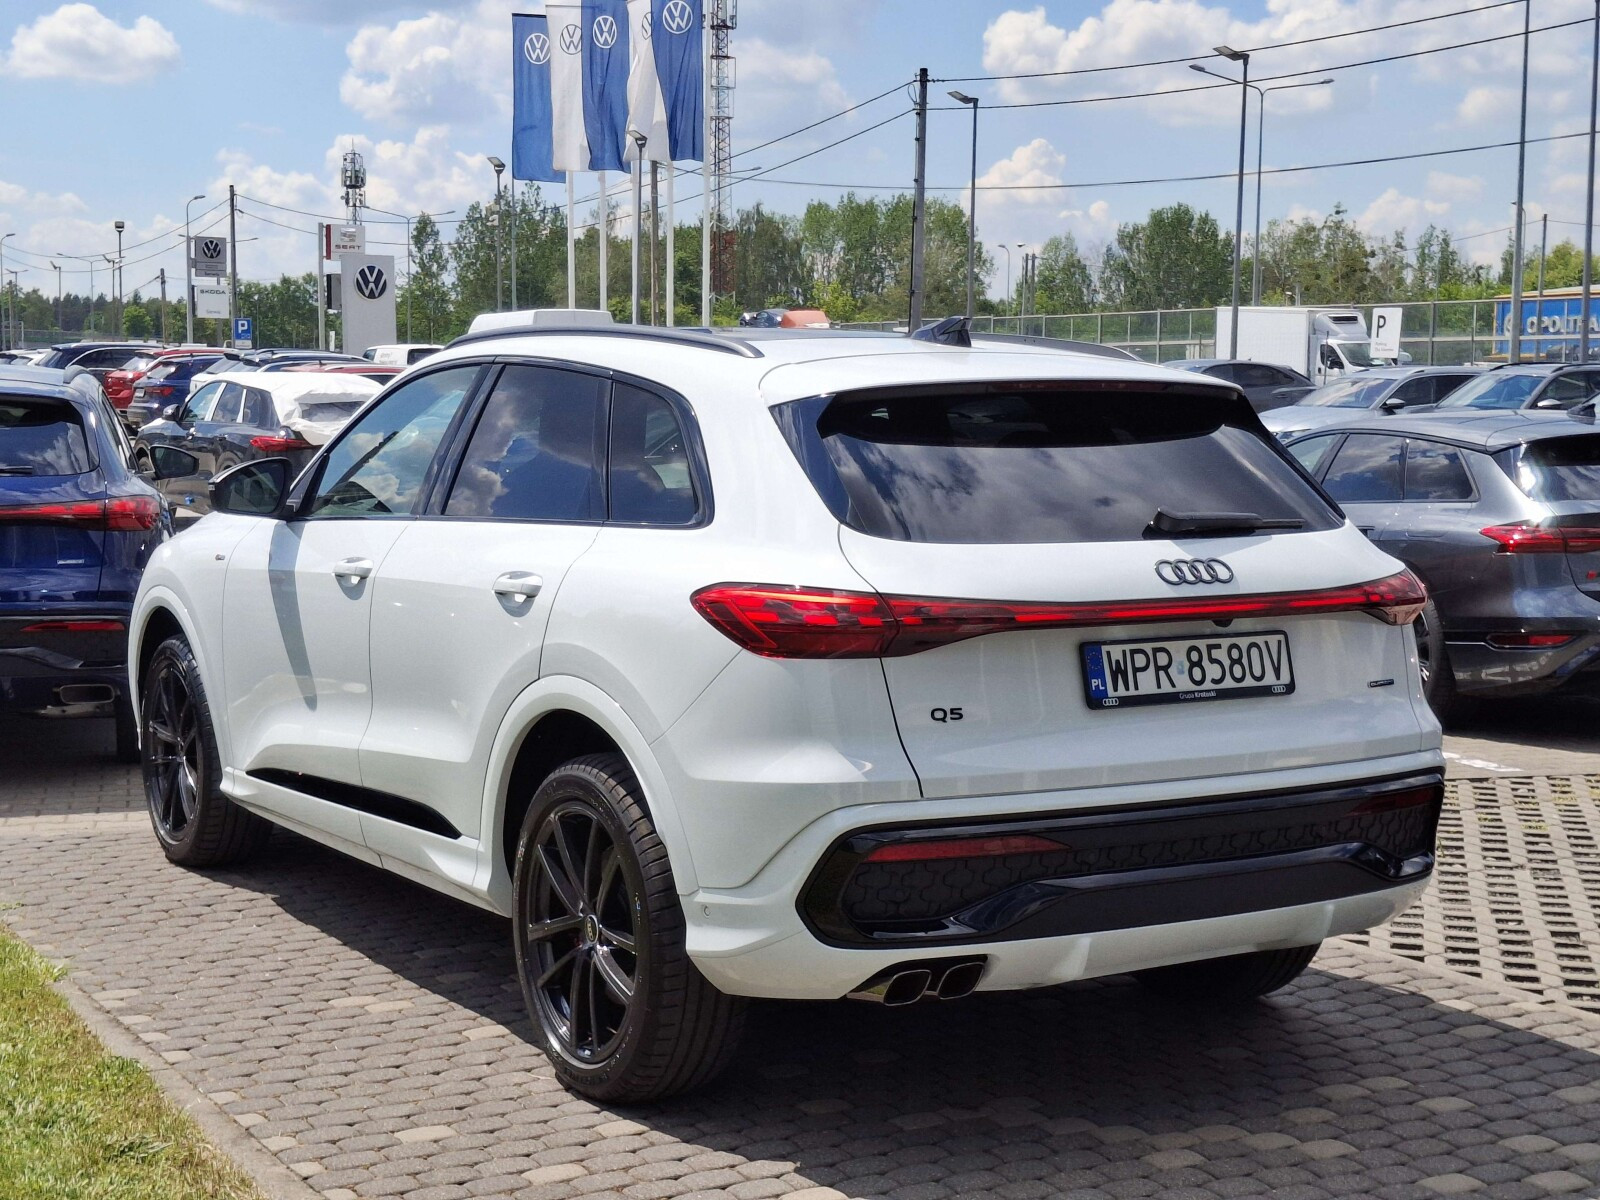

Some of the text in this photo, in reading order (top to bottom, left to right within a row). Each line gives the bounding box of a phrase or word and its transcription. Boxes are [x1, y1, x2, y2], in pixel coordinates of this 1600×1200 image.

[662, 0, 693, 35] VW
[592, 15, 617, 49] VW
[355, 264, 388, 301] VW
[238, 320, 248, 334] P
[1376, 315, 1387, 338] P
[1105, 639, 1282, 693] WPR 8580V
[1091, 679, 1105, 690] PL
[930, 707, 964, 723] Q5
